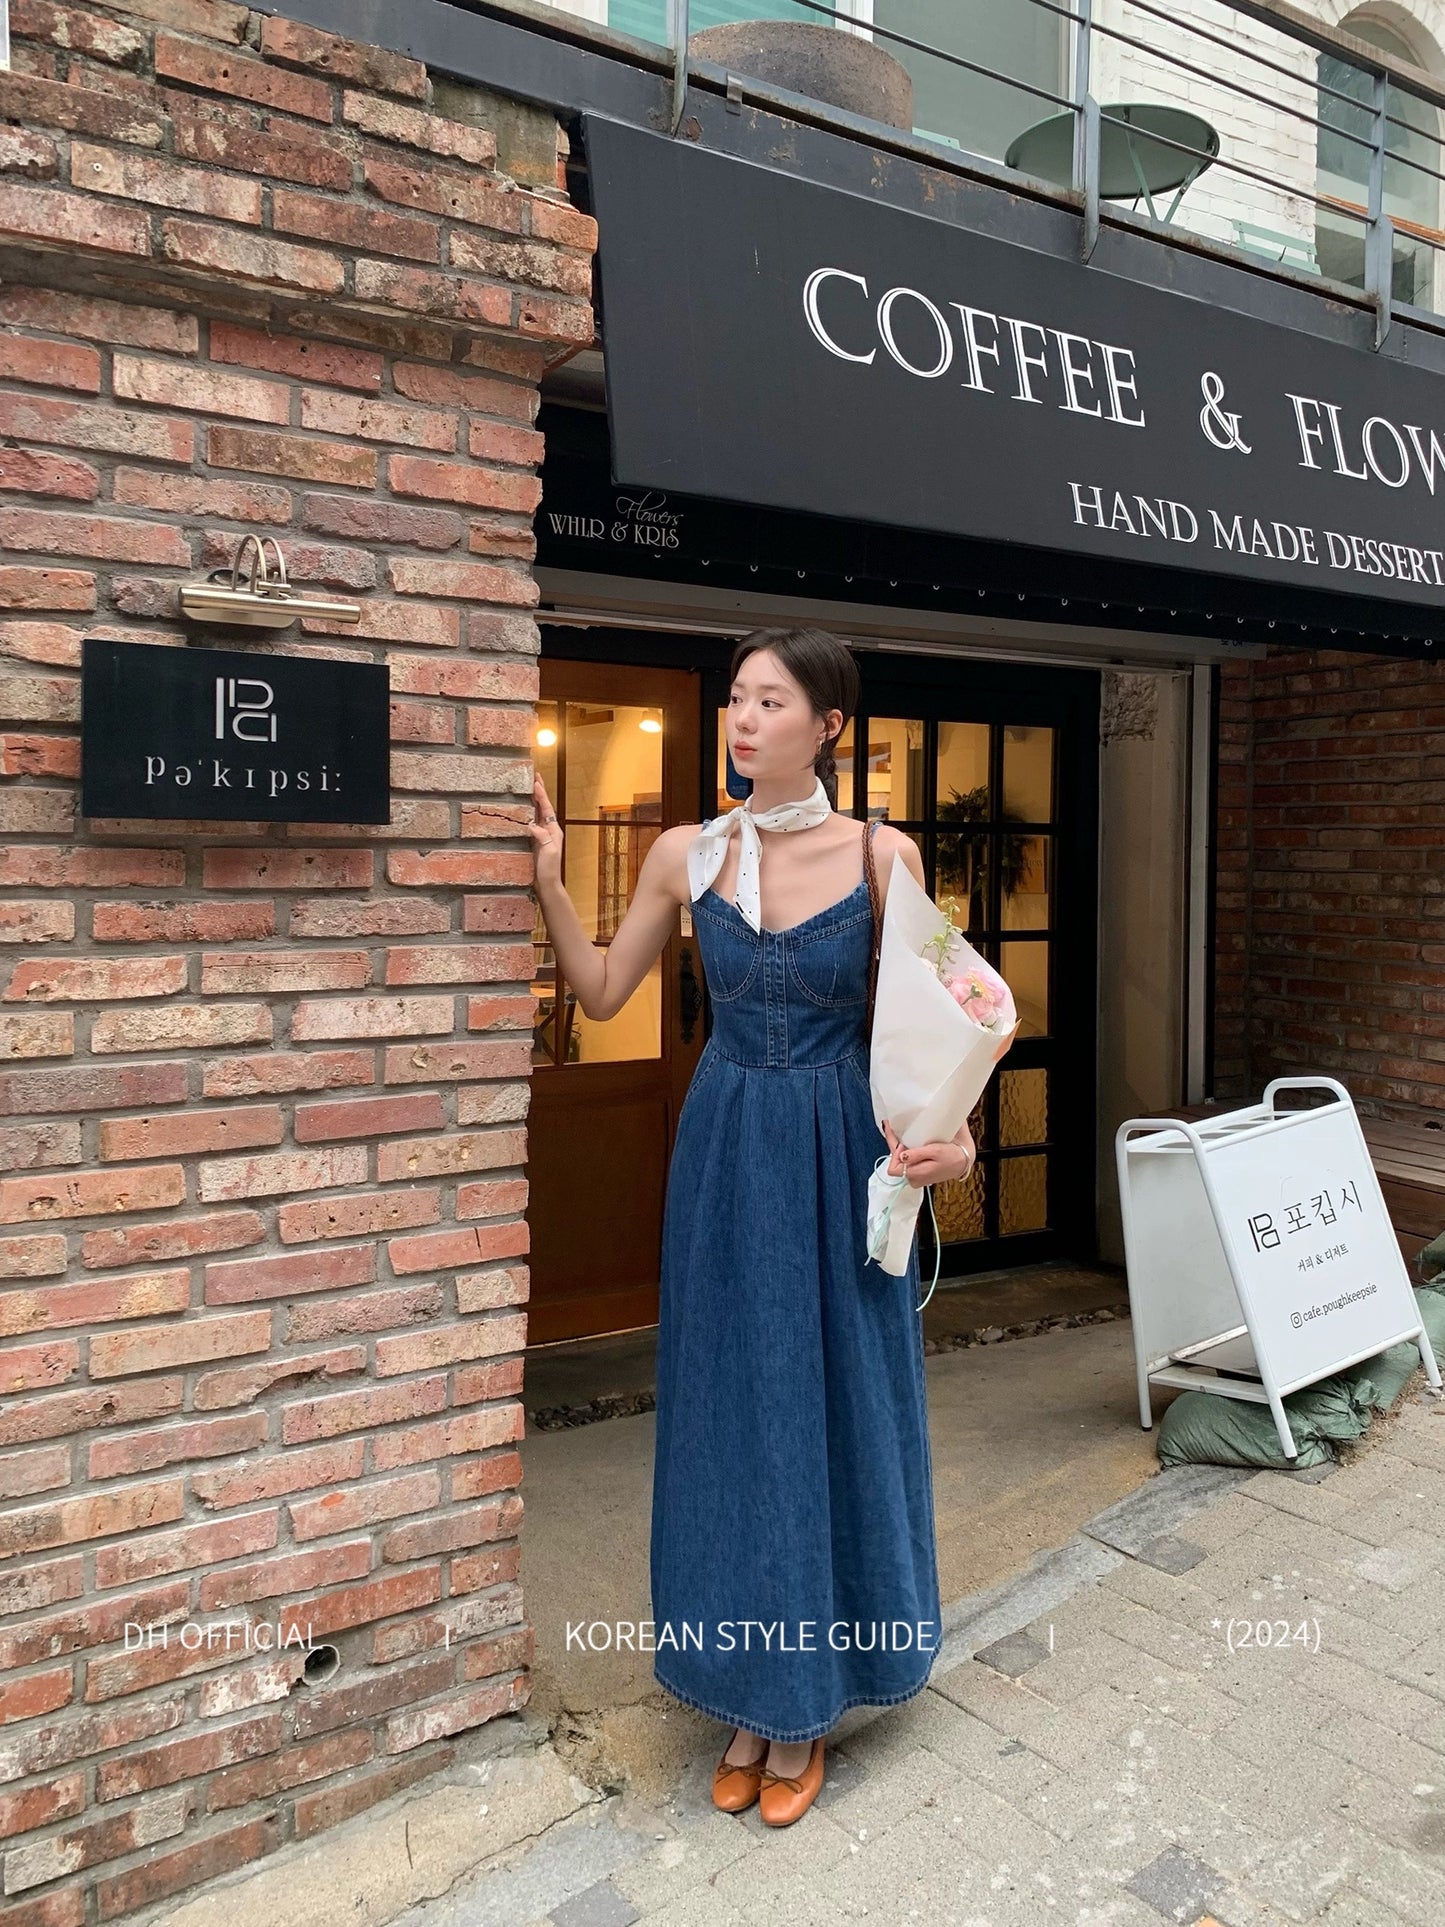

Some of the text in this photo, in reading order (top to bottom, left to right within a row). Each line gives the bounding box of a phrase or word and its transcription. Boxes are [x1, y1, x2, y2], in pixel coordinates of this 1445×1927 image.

[803, 267, 1146, 428] COFFEE
[1199, 371, 1252, 454] &
[616, 491, 684, 526] Flowers
[611, 521, 629, 542] &
[633, 524, 680, 549] KRIS
[1067, 481, 1445, 586] HAND MADE DESSERT
[1283, 1180, 1363, 1235] 포킵시
[1297, 1243, 1349, 1272] 커피 & 디저트
[1302, 1282, 1378, 1323] cafe.poughkeepsie
